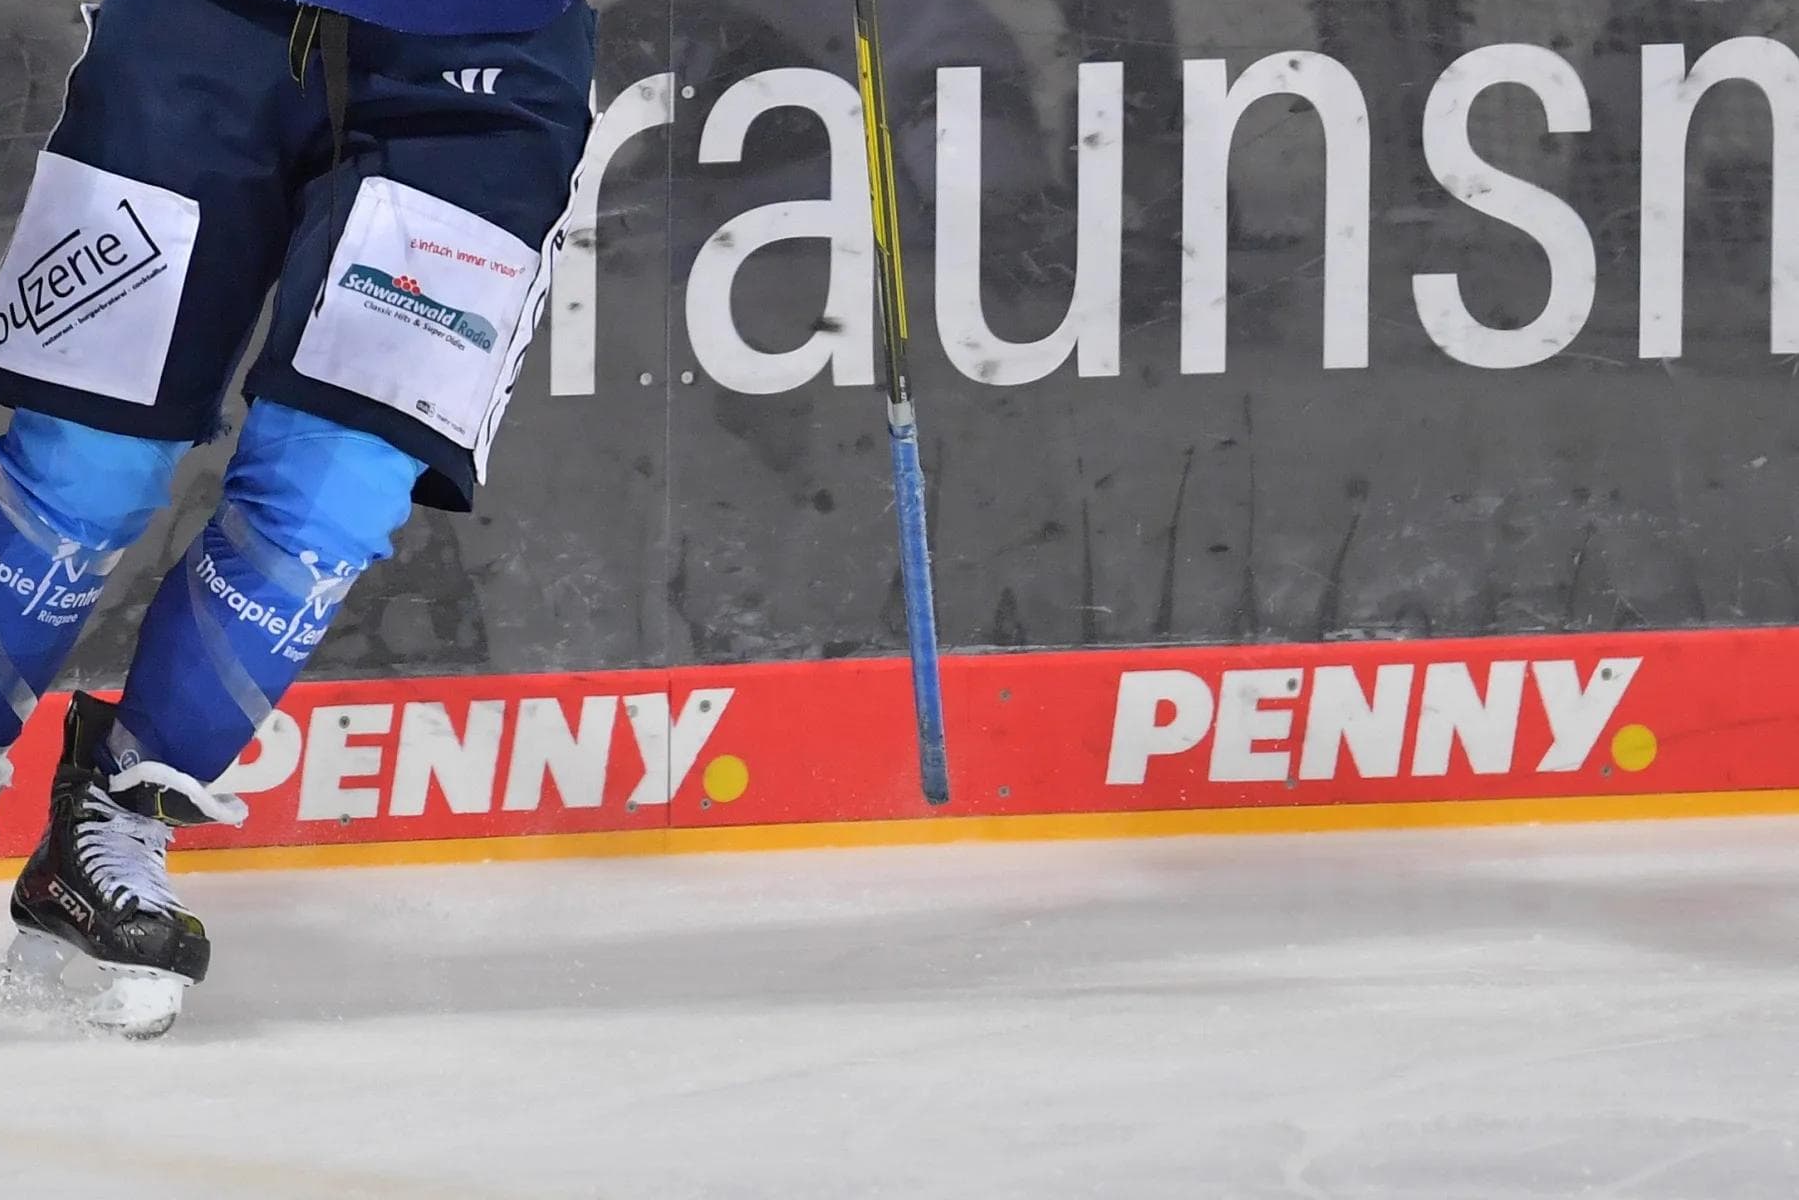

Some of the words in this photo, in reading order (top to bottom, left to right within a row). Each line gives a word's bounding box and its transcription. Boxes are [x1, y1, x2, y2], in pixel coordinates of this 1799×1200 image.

[344, 272, 456, 328] Schwarzwald
[458, 319, 492, 350] Radio
[363, 300, 393, 317] Classic
[423, 321, 446, 339] Super
[195, 552, 288, 636] Therapie
[47, 880, 88, 923] CCM
